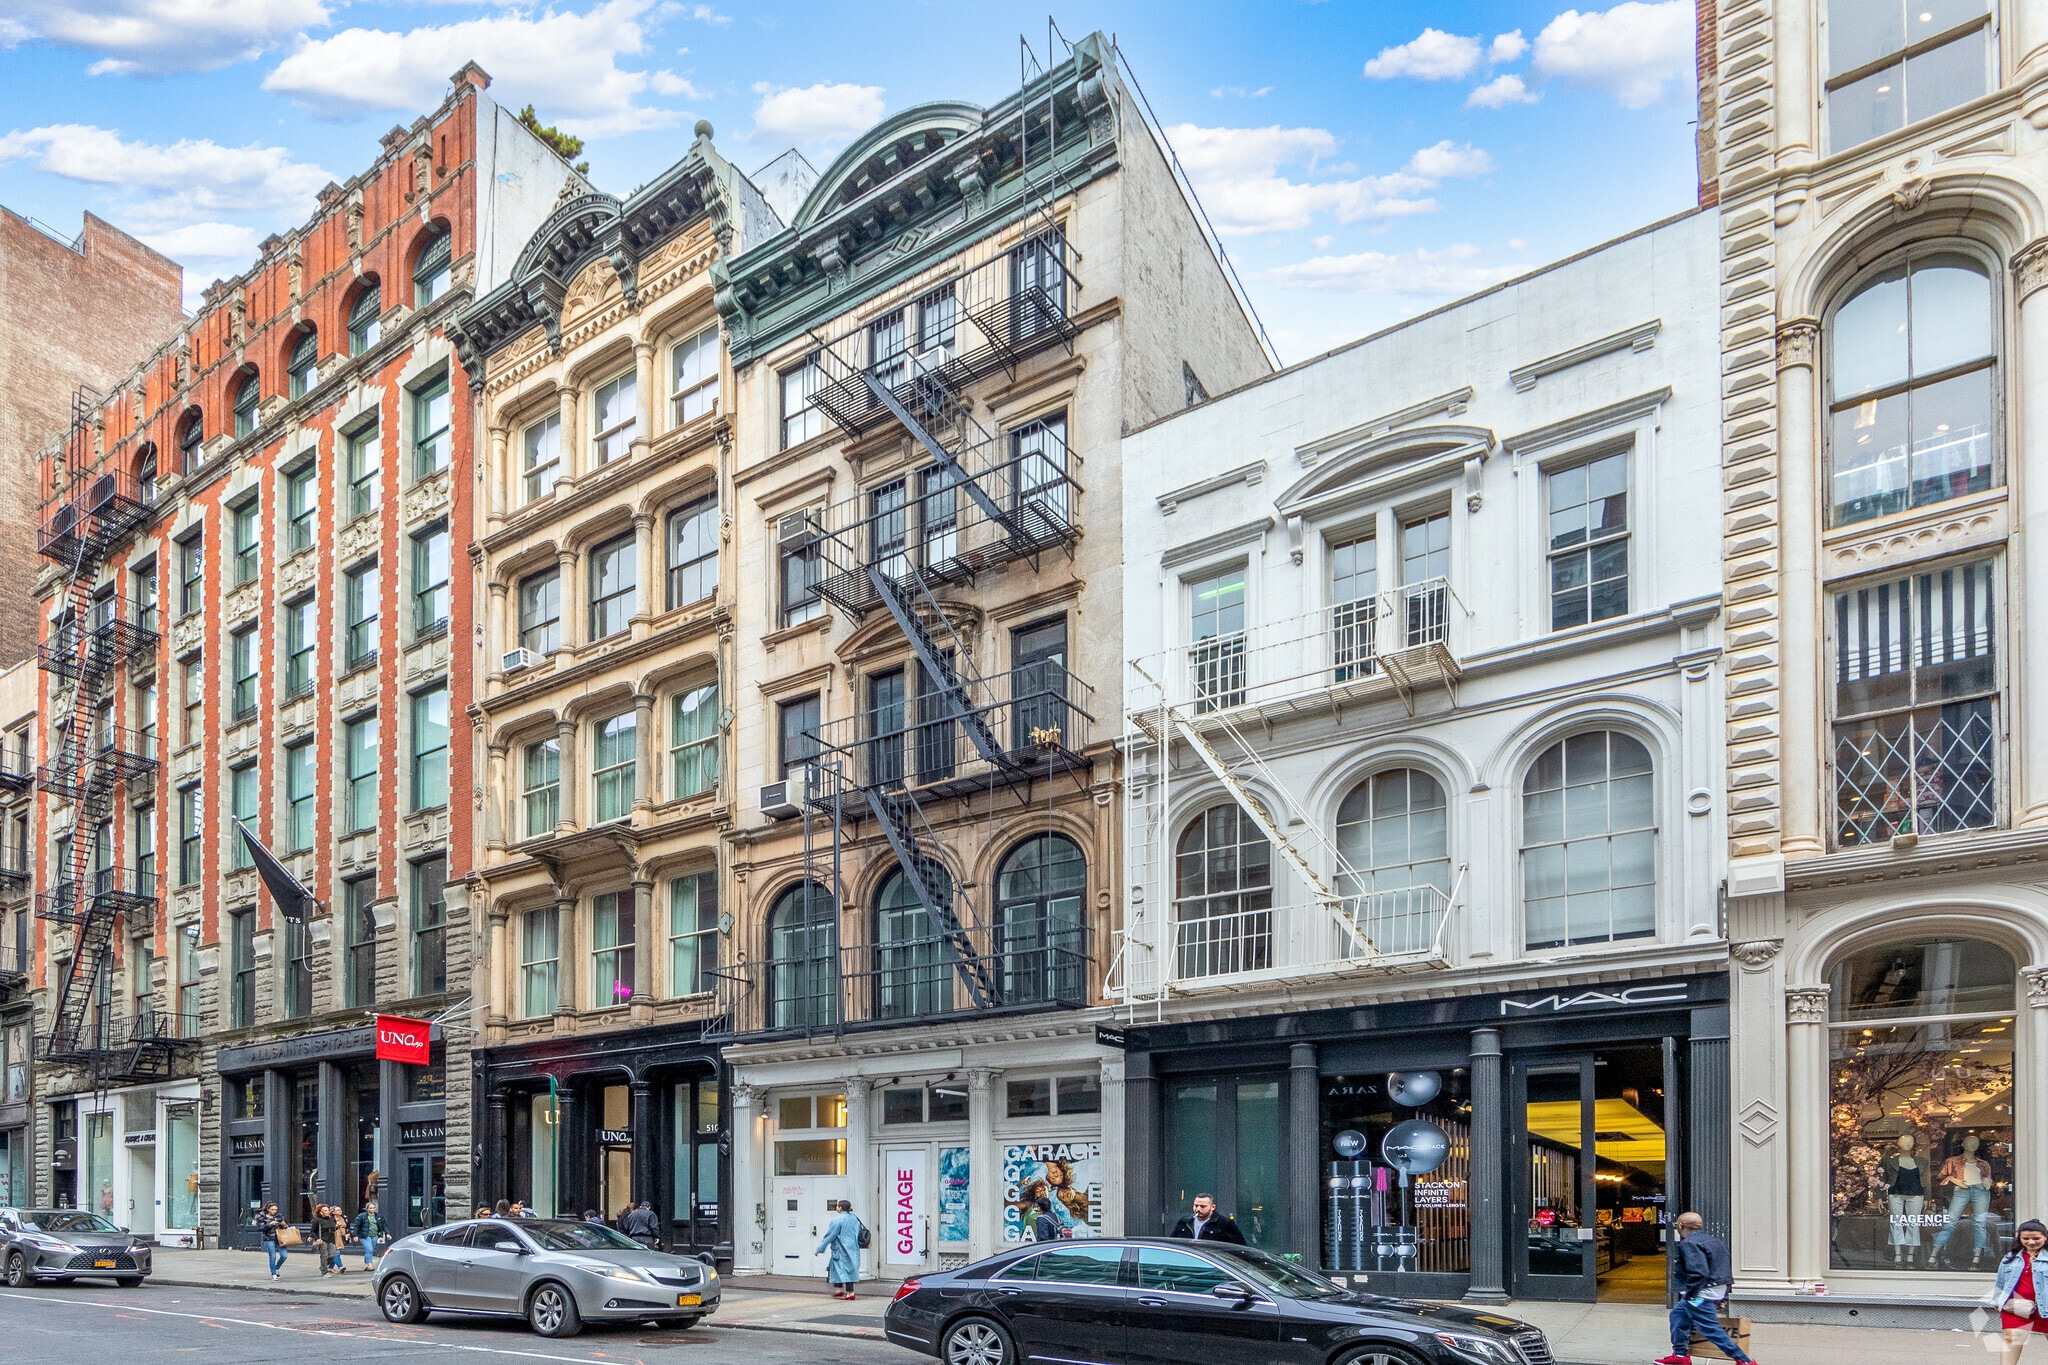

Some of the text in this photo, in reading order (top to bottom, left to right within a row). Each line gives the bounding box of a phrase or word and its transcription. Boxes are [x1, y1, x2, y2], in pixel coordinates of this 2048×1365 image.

[251, 1042, 310, 1062] ALLSAINTS
[403, 1127, 445, 1139] ALLSAIN
[235, 1140, 265, 1150] ALLSAIN
[897, 1169, 914, 1255] GARAGE
[1889, 1214, 1951, 1224] L'AGENCE
